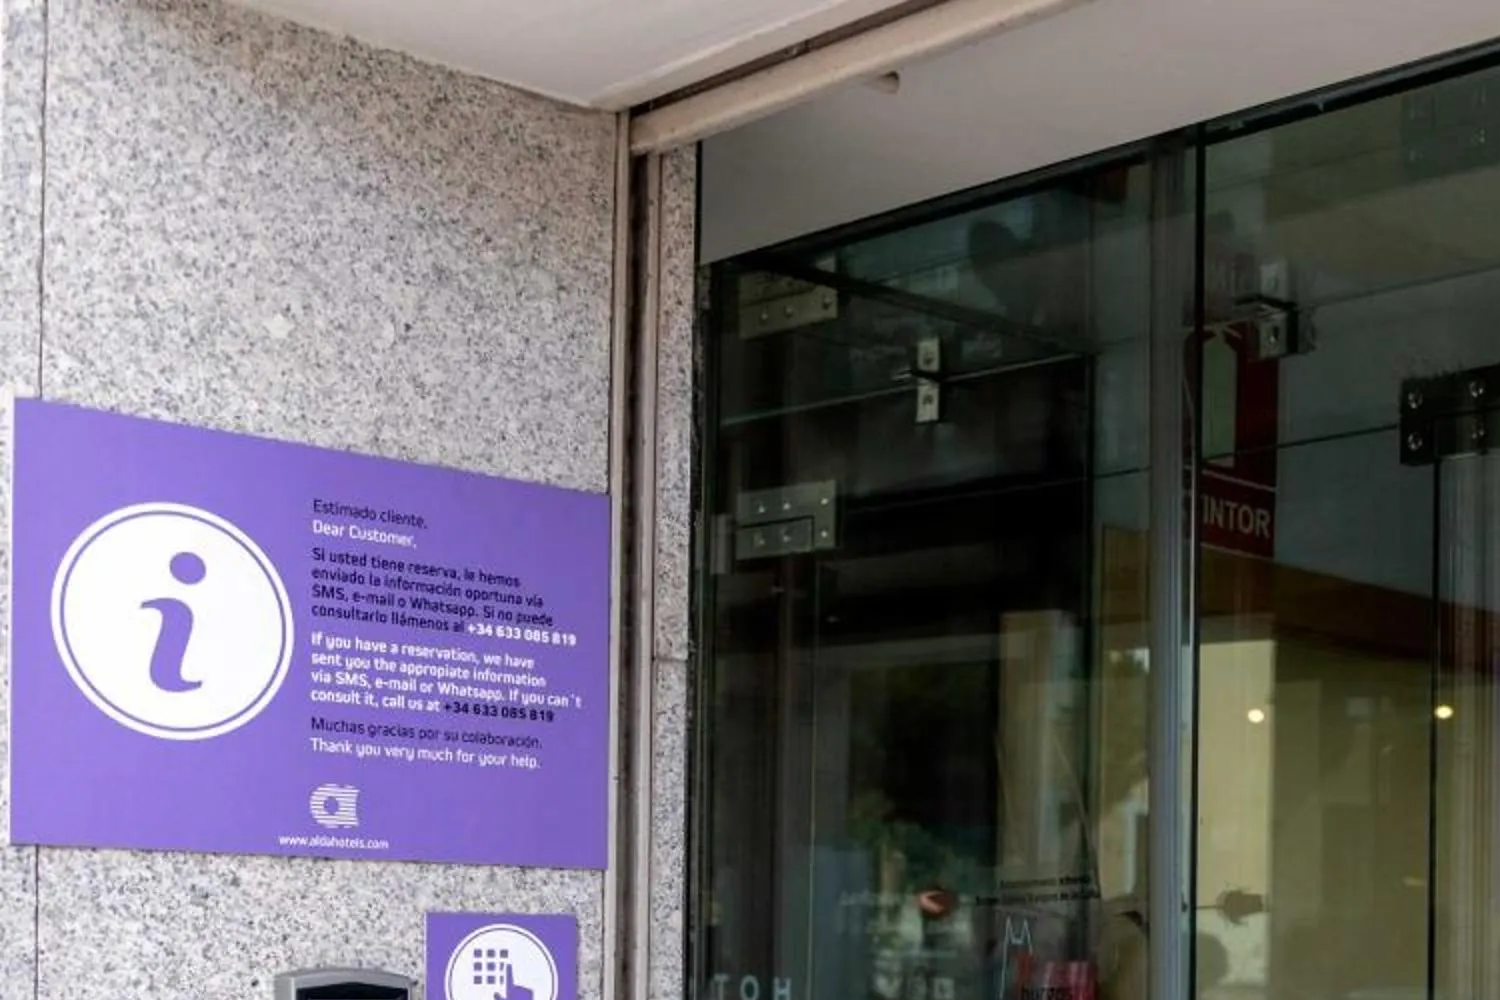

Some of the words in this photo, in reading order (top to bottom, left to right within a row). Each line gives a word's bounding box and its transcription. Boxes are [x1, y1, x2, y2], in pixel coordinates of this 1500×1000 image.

[313, 499, 376, 521] Estimado
[313, 519, 344, 537] Dear
[350, 526, 417, 548] Customer,
[312, 548, 326, 562] Si
[329, 552, 367, 567] usted
[371, 556, 405, 572] tiene
[479, 569, 520, 588] hemos
[311, 567, 365, 585] enviado
[465, 588, 523, 605] oportuna
[311, 583, 348, 602] SMS,
[352, 590, 395, 607] e-mail
[397, 597, 407, 609] o
[483, 605, 495, 619] Si
[497, 610, 513, 621] no
[516, 612, 553, 627] puede
[311, 604, 388, 624] consultarlo
[467, 623, 493, 637] +34
[495, 625, 521, 640] 633
[312, 632, 322, 646] If
[326, 635, 351, 650] you
[355, 637, 386, 653] have
[390, 642, 399, 654] a
[401, 642, 479, 665] reservation,
[484, 653, 502, 667] we
[505, 654, 535, 669] have
[311, 653, 342, 667] sent
[345, 656, 370, 671] you
[374, 658, 397, 673] the
[473, 667, 547, 687] information
[311, 688, 361, 705] consult
[382, 694, 404, 709] call
[408, 699, 423, 711] us
[426, 699, 441, 713] at
[444, 702, 470, 714] +34
[473, 703, 498, 717] 633
[529, 709, 554, 723] 819
[336, 672, 371, 689] SMS,
[375, 677, 416, 692] e-mail
[420, 682, 435, 694] or
[509, 690, 518, 702] If
[522, 693, 545, 707] you
[311, 716, 365, 734] Muchas
[368, 721, 415, 738] gracias
[418, 727, 441, 741] por
[444, 730, 459, 742] su
[461, 730, 542, 749] colaboración.
[311, 737, 352, 753] Thank
[356, 741, 380, 757] you
[384, 744, 415, 761] very
[418, 745, 452, 762] much
[457, 749, 473, 763] for
[478, 752, 506, 767] your
[511, 752, 540, 769] help.
